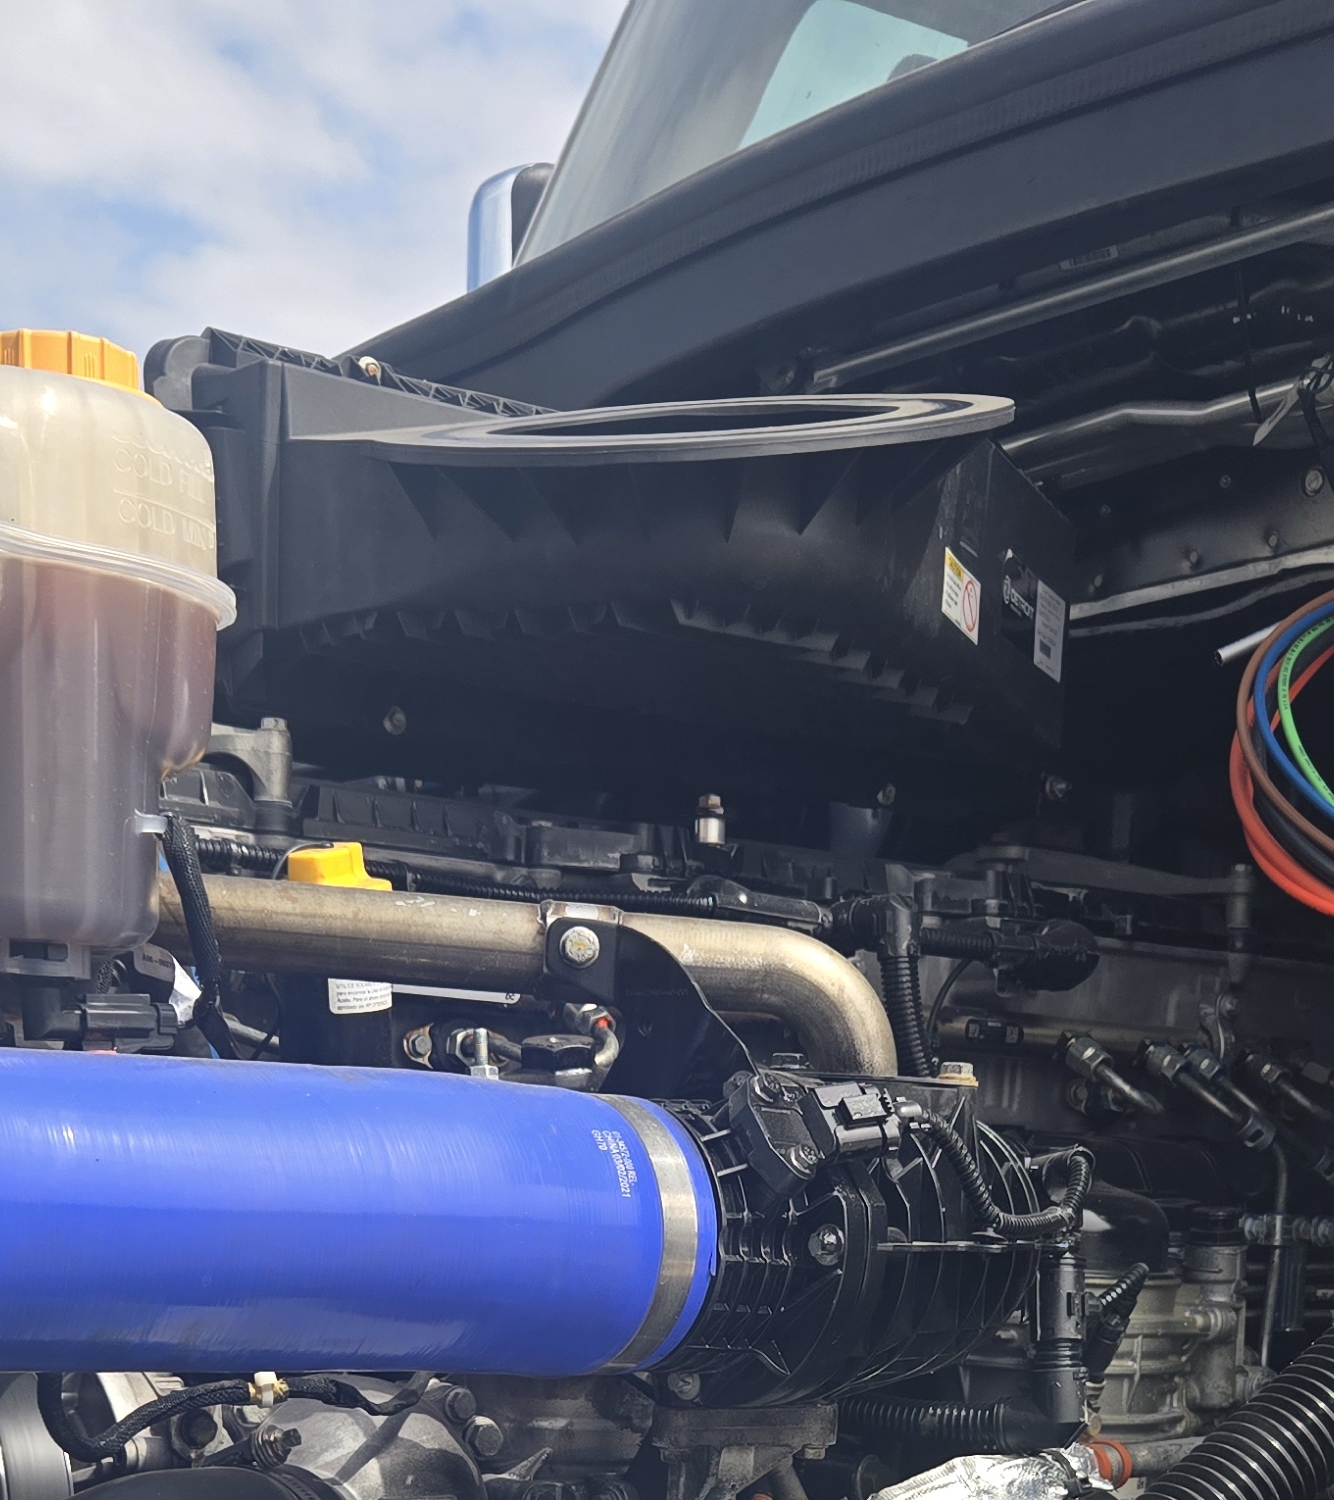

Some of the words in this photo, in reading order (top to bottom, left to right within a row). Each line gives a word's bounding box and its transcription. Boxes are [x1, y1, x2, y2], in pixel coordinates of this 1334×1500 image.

[114, 447, 173, 487] COLD
[118, 497, 176, 535] COLD
[1010, 587, 1035, 620] DETROIT
